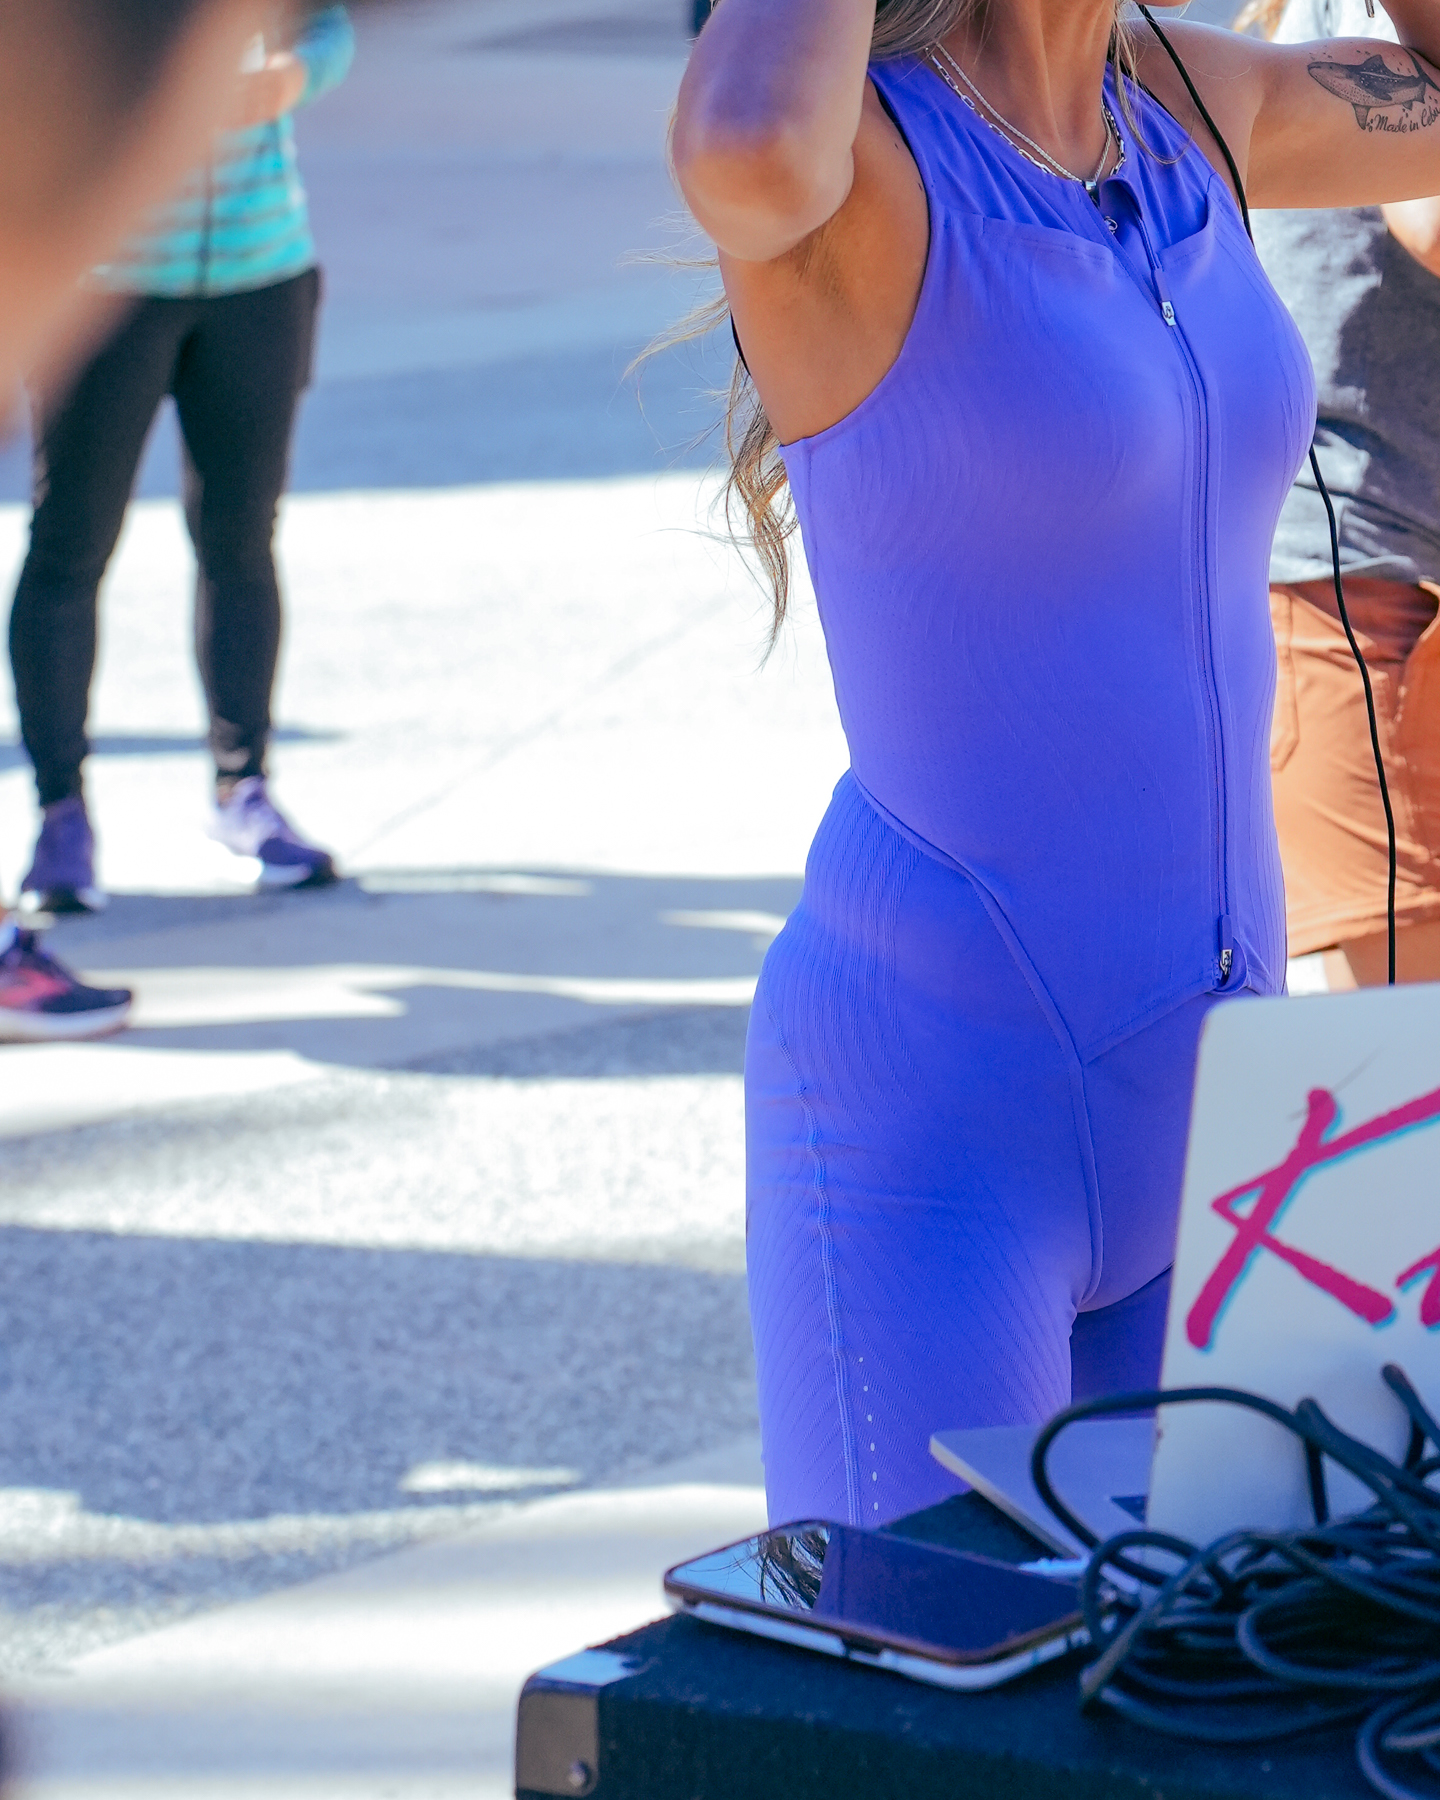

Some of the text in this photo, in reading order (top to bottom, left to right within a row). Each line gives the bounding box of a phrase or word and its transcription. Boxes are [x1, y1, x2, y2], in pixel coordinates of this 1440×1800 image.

[1374, 105, 1440, 133] Made in Cebu
